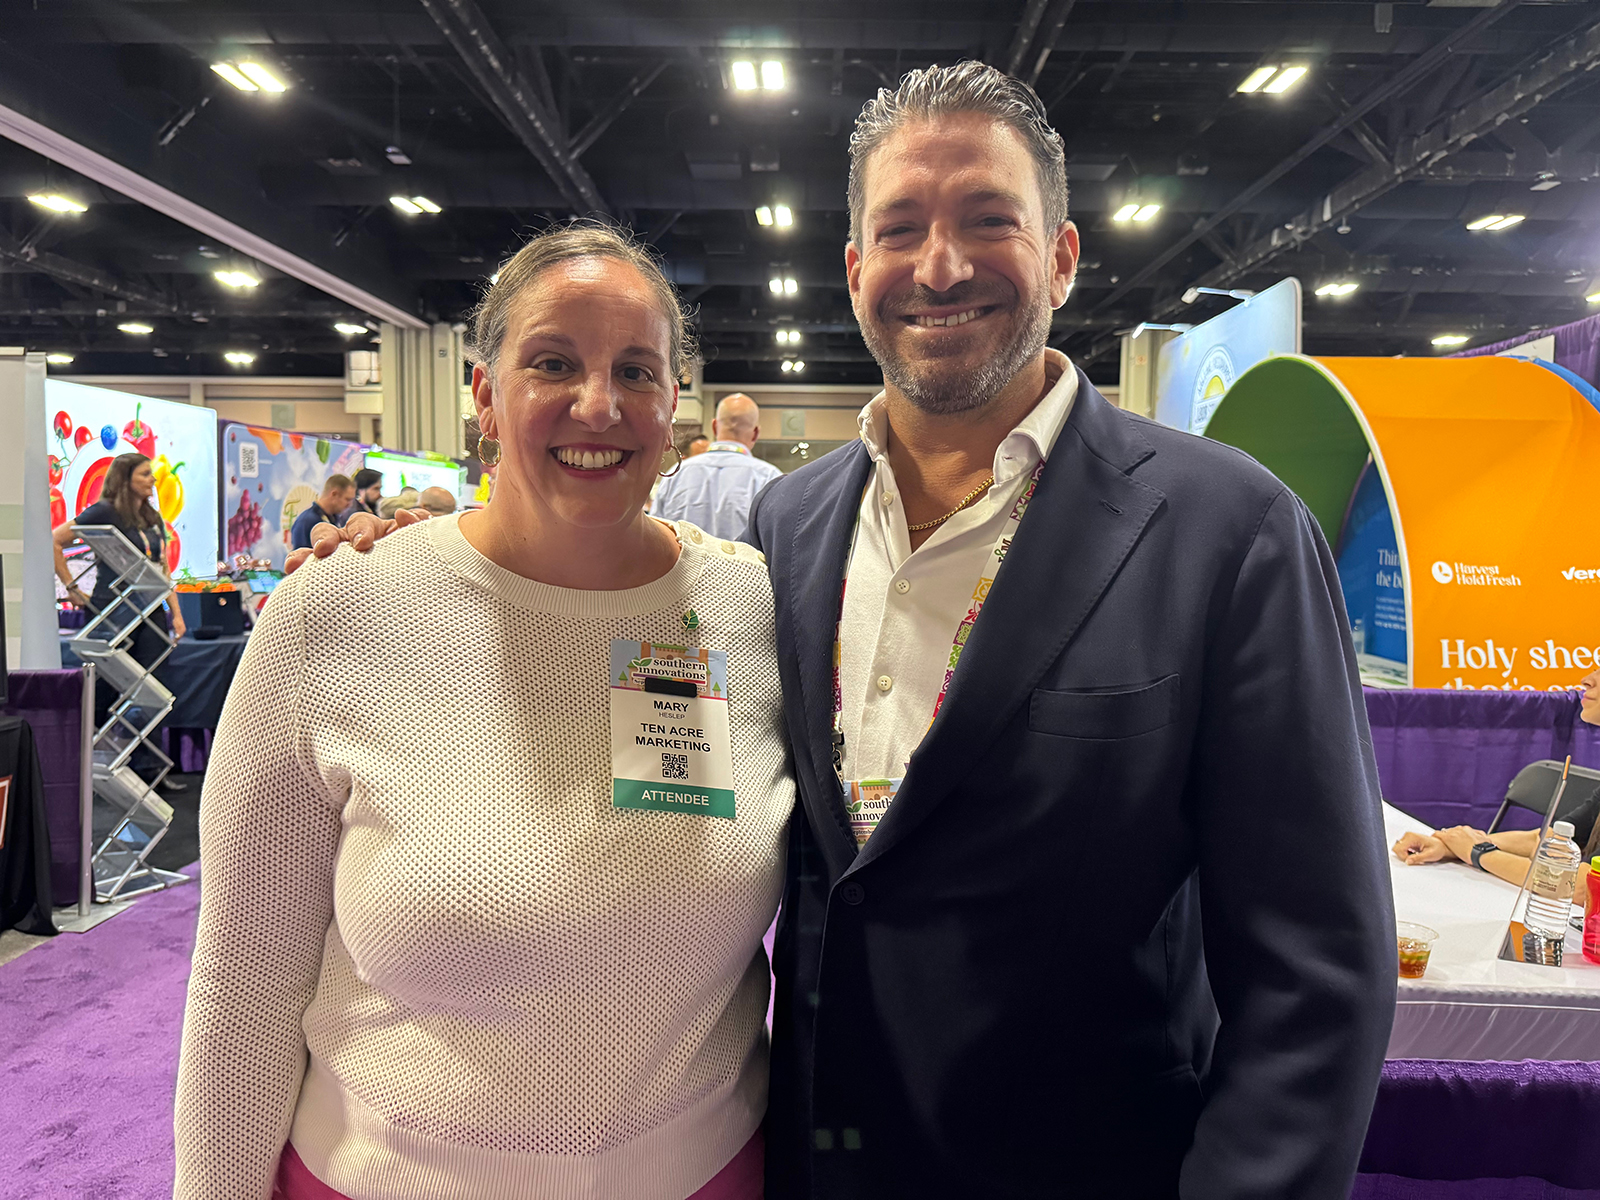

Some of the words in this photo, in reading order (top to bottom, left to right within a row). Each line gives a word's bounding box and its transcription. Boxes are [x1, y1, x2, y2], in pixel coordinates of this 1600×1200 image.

[1454, 562, 1499, 575] Harvest
[1376, 570, 1391, 588] the
[1456, 574, 1485, 586] Hold
[1486, 574, 1522, 587] Fresh
[653, 658, 706, 671] southern
[1440, 639, 1518, 678] Holy
[639, 667, 706, 680] innovations
[653, 700, 689, 712] MARY
[658, 712, 686, 720] HESLEP
[640, 723, 666, 735] TEN
[669, 726, 704, 738] ACRE
[635, 735, 711, 752] MARKETING
[641, 789, 710, 807] ATTENDEE
[863, 798, 892, 809] south
